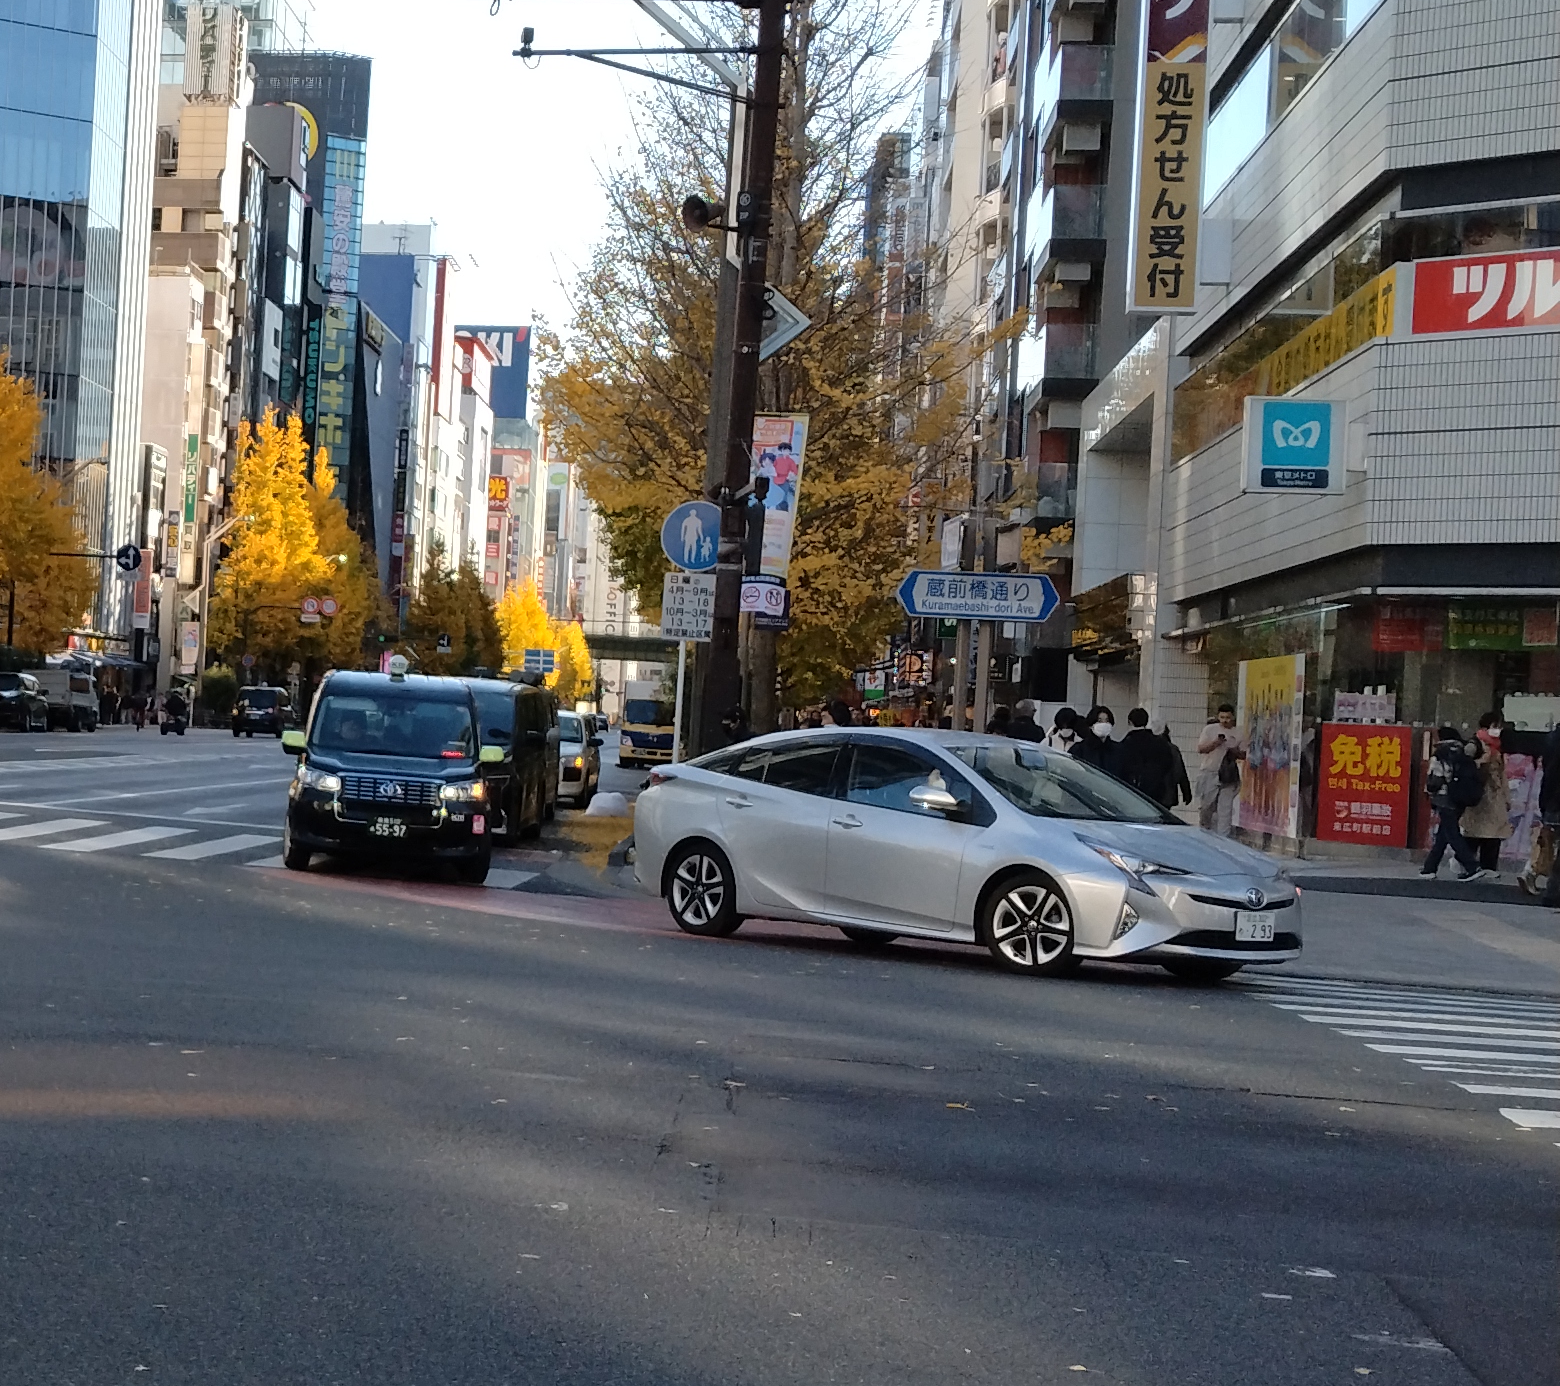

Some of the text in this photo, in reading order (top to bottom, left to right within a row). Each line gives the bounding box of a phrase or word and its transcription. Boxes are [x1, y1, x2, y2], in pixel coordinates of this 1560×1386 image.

[1147, 71, 1195, 299] 処方せん受付
[454, 330, 513, 367] KI
[304, 318, 320, 425] TSUKUMO
[925, 578, 1030, 602] 蔵前橋通り
[922, 599, 1012, 614] Kuramaebashi-dori
[1329, 734, 1401, 777] 免税
[1351, 779, 1400, 792] Tax-Free
[375, 824, 406, 837] 55-97
